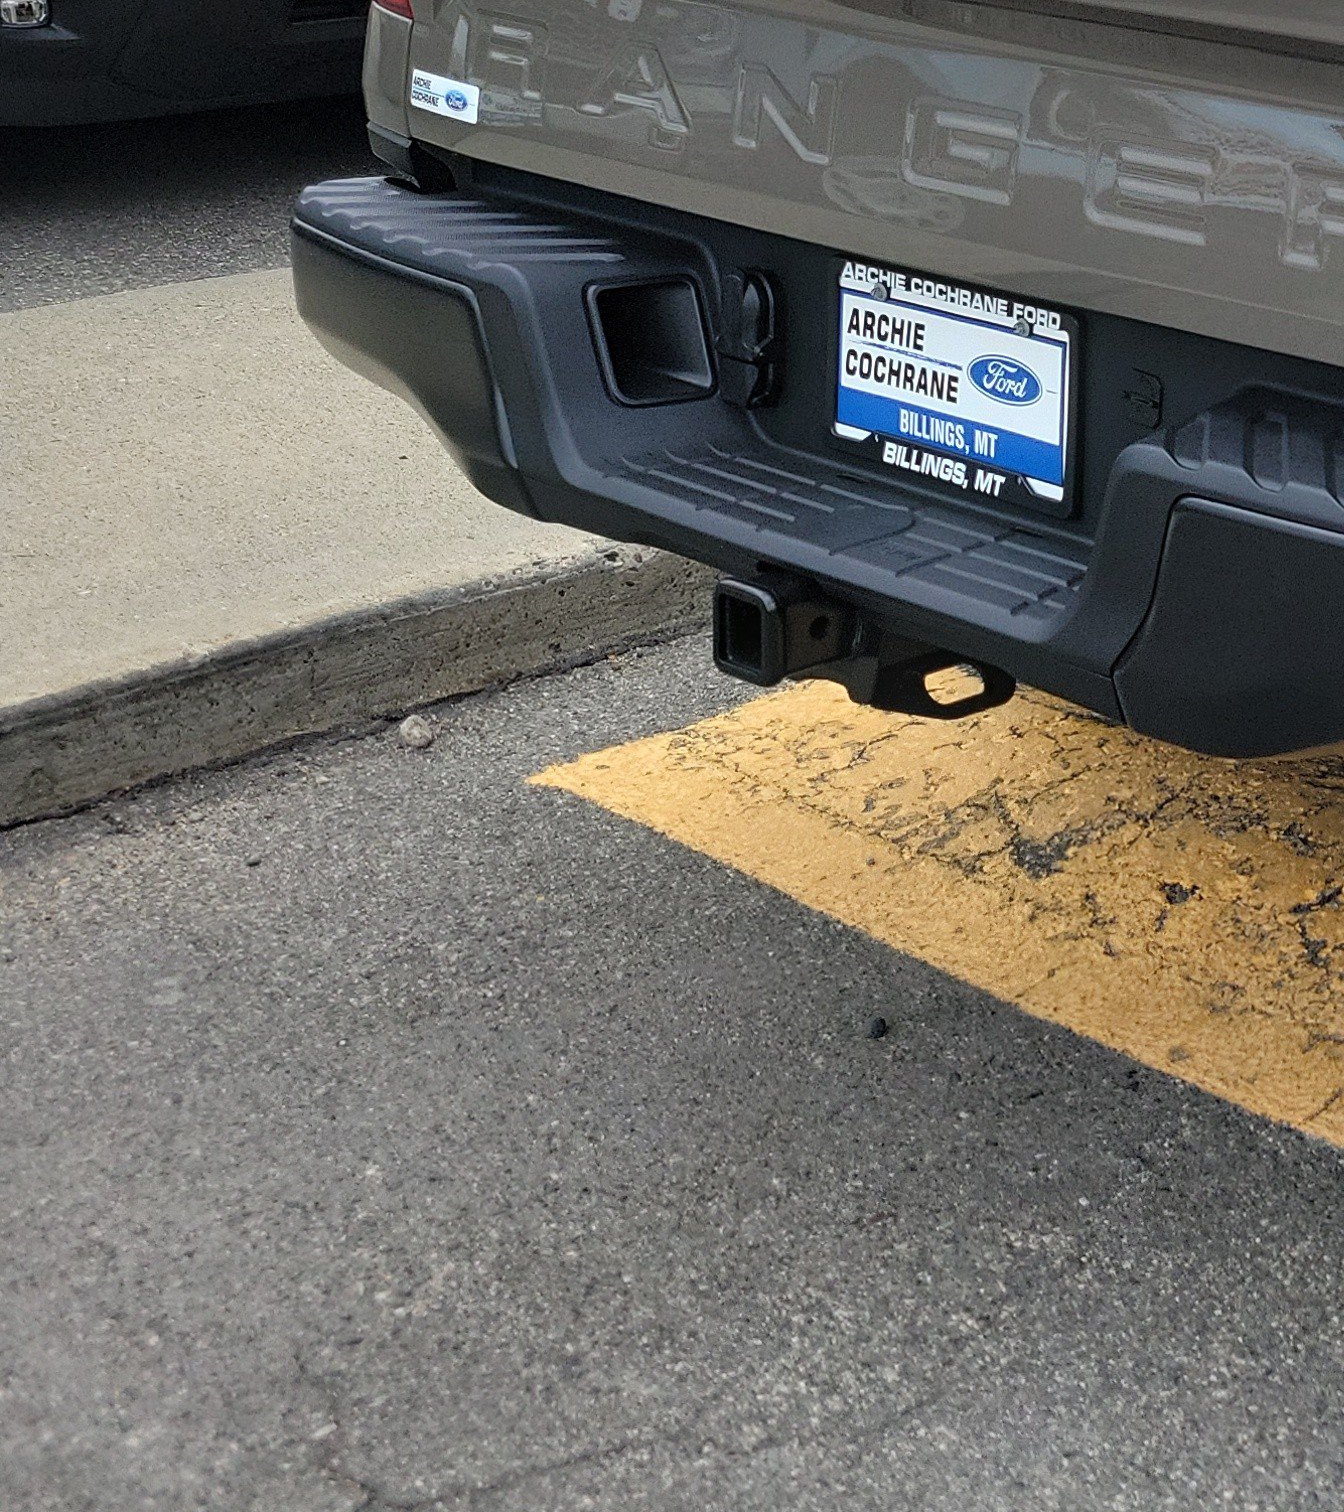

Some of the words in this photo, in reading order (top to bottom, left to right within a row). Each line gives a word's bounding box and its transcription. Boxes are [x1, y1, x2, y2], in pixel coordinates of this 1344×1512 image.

[841, 262, 906, 292] ARCHIE
[910, 277, 1008, 317] COCHRANE
[1012, 302, 1061, 330] FORD
[847, 307, 926, 352] ARCHIE
[845, 348, 959, 404] COCHRANE
[982, 360, 1027, 398] Ford
[899, 408, 970, 455] BILLINGS,
[974, 430, 999, 458] MT
[882, 443, 969, 489] BILLINGS,
[973, 469, 1006, 497] MT
